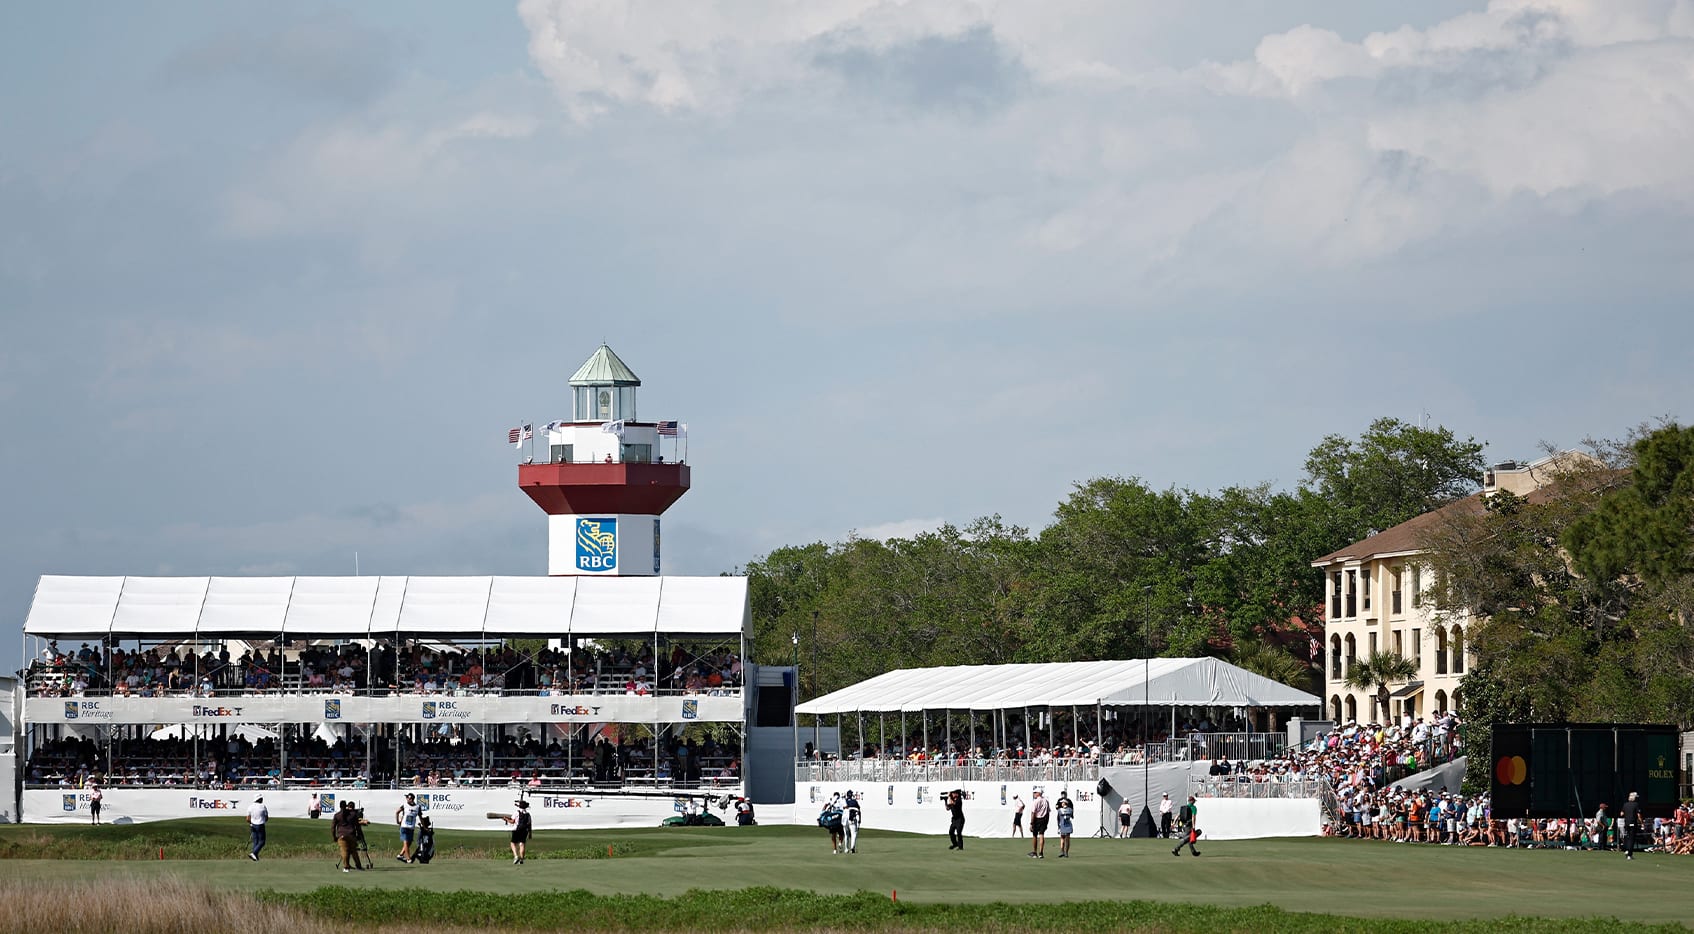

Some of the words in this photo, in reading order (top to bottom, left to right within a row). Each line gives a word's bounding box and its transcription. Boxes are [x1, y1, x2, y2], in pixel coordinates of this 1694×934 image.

[580, 555, 613, 568] RBC
[81, 701, 100, 709] RBC
[439, 701, 457, 709] RBC
[81, 710, 114, 719] Heritage
[202, 706, 232, 716] FedEx
[438, 710, 471, 719] Heritage
[560, 705, 589, 715] FedEx
[1648, 769, 1674, 778] ROLEX
[432, 793, 451, 802] RBC
[199, 799, 228, 809] FedEx
[432, 802, 465, 812] Heritage
[553, 798, 581, 808] FedEx
